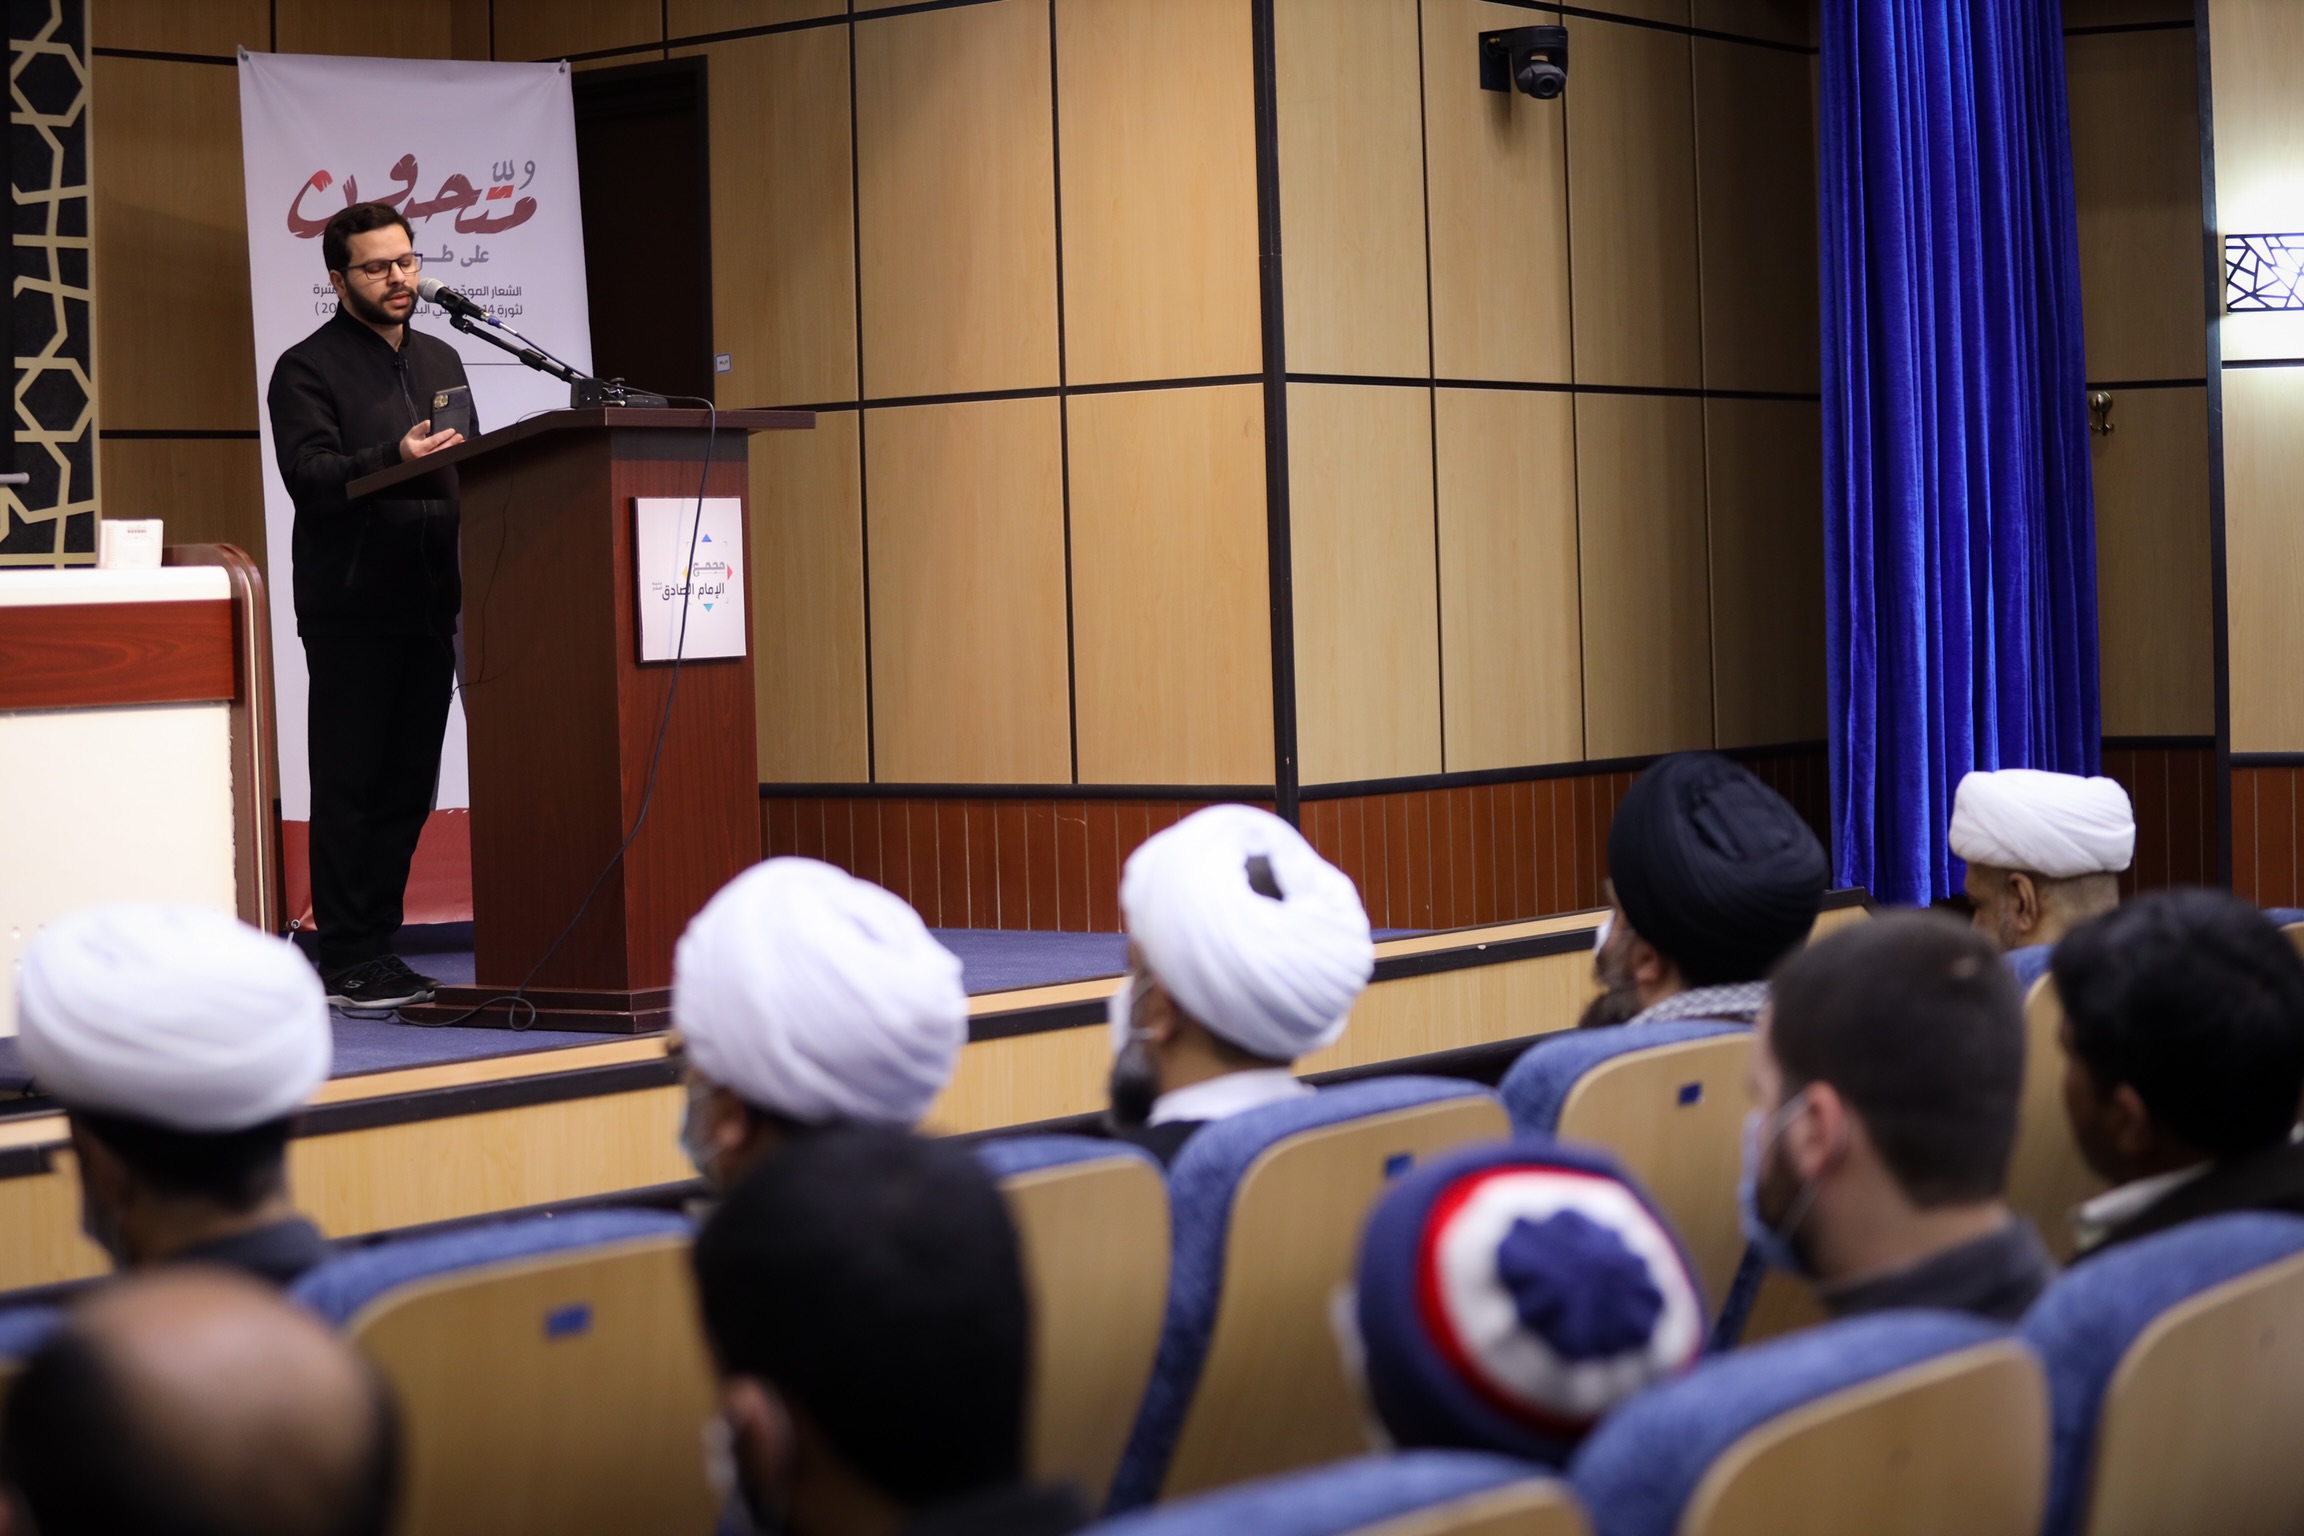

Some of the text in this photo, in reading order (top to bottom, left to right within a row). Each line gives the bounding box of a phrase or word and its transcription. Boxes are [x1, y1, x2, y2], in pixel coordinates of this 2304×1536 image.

[460, 243, 489, 267] على
[491, 284, 522, 299] الشعار
[662, 583, 694, 600] الصادق
[698, 582, 724, 600] الإمام
